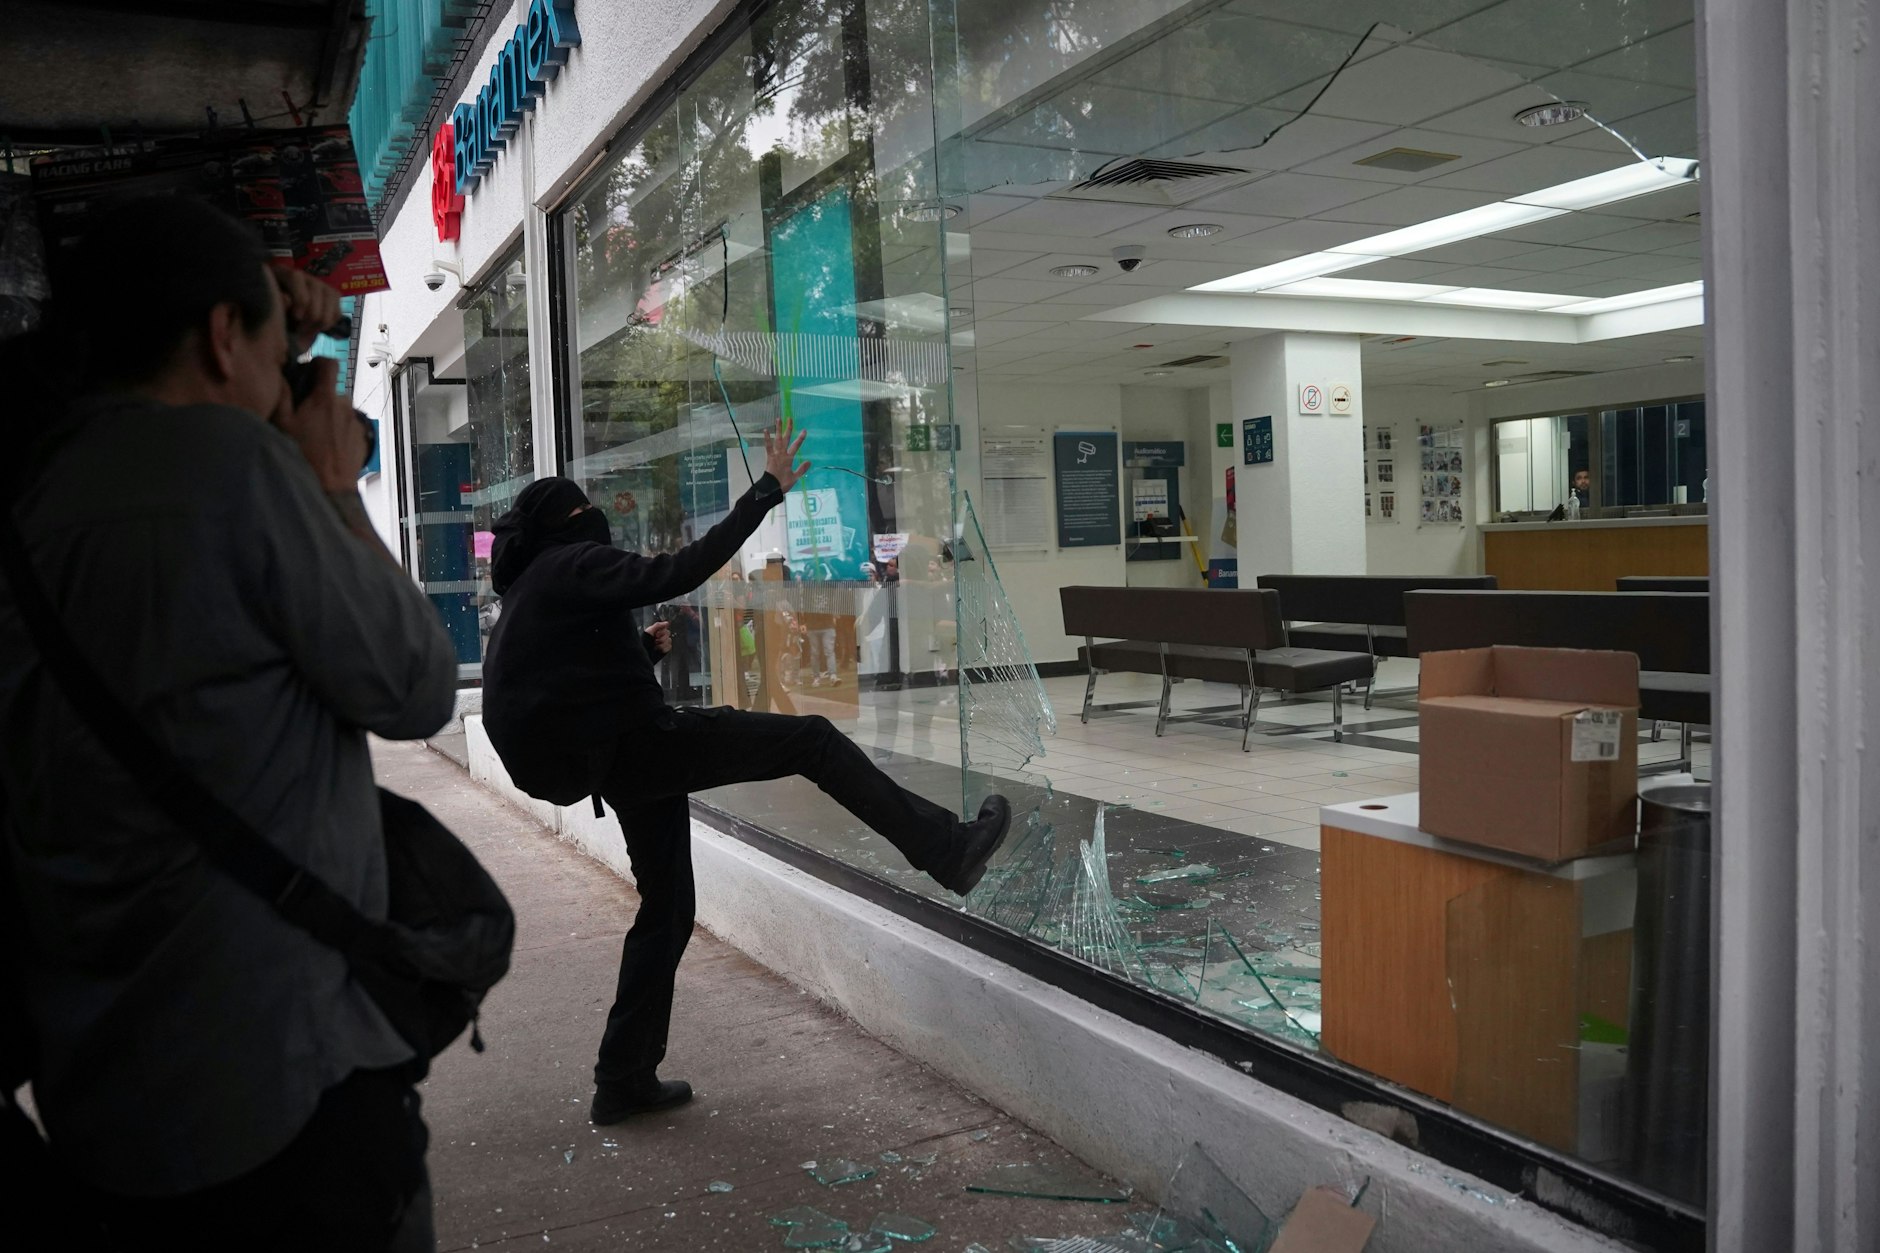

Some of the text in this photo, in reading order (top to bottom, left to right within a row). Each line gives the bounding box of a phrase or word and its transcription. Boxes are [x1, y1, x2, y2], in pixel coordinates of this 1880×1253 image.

[39, 158, 132, 178] RACING CARS
[1678, 423, 1686, 435] 2
